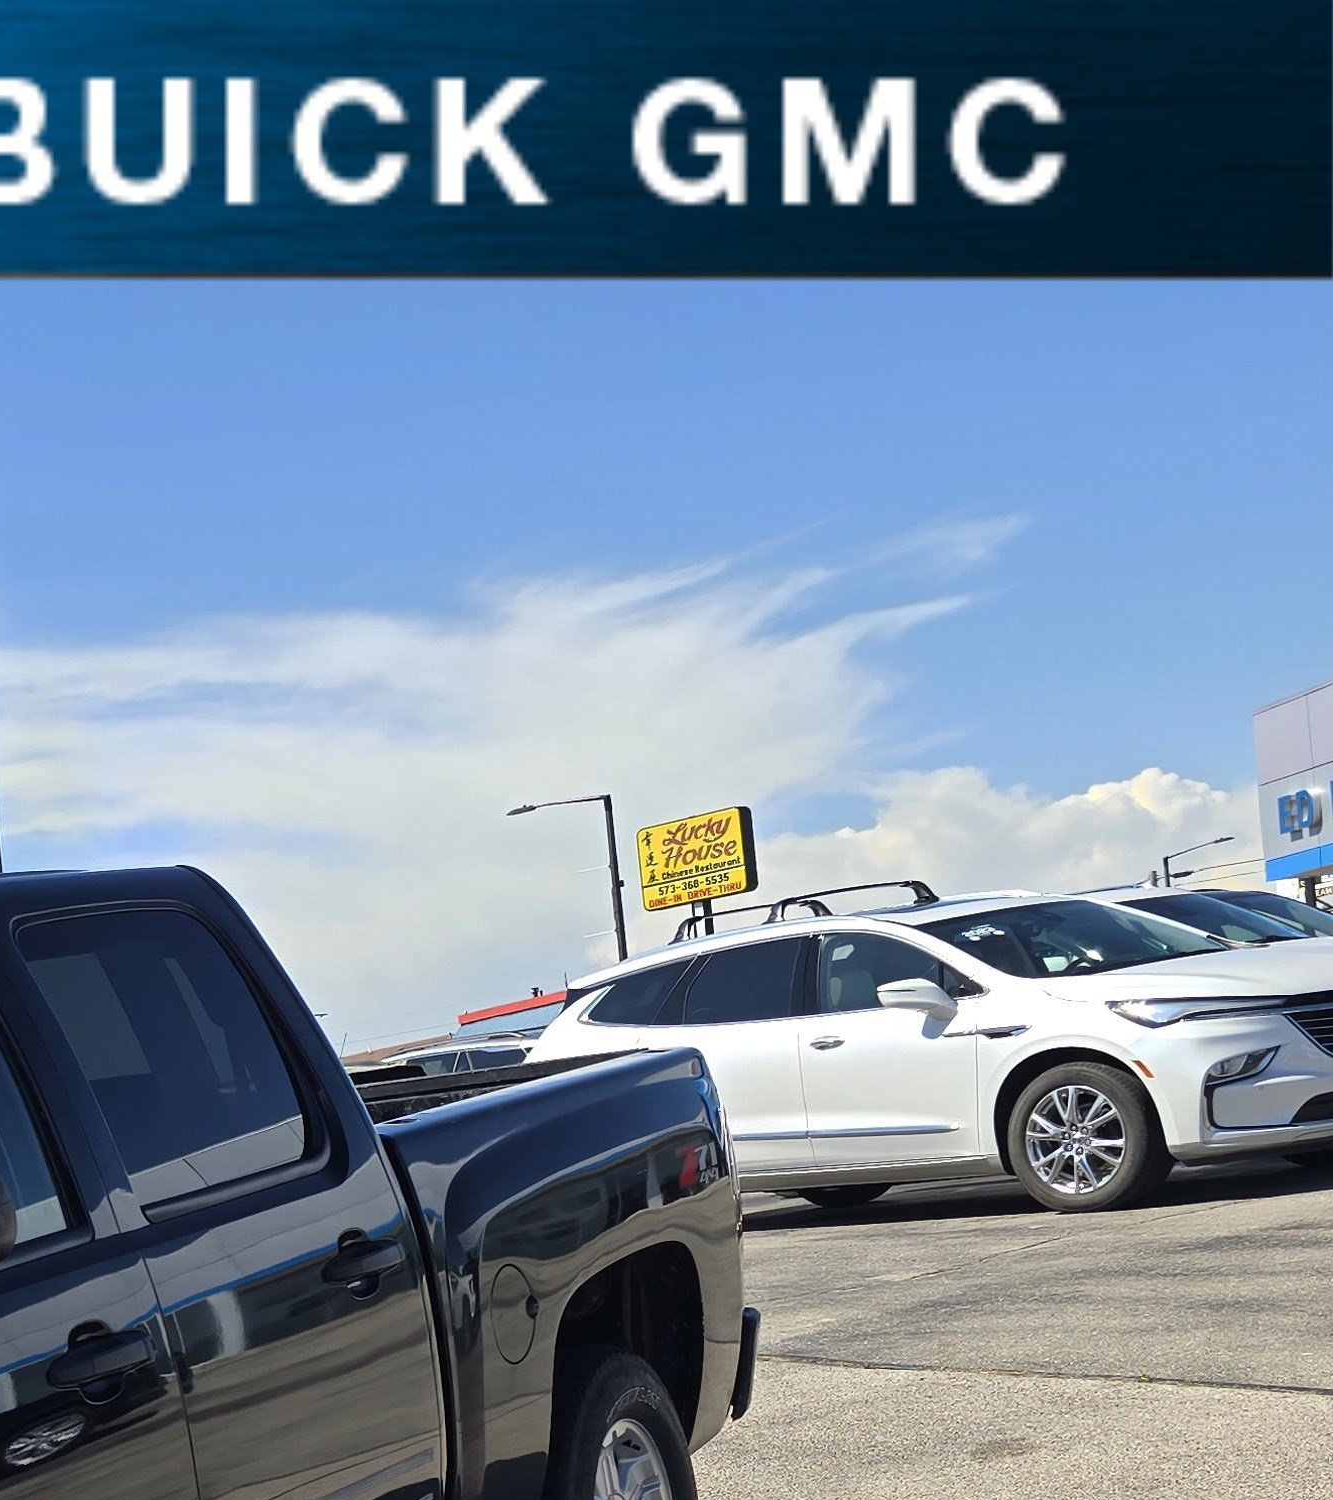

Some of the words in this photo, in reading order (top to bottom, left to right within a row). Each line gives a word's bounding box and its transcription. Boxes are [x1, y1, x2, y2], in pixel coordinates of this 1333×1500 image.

[1277, 789, 1314, 835] ED
[663, 816, 731, 846] Lucky
[661, 839, 738, 869] House
[661, 868, 694, 881] Chinese
[694, 856, 741, 875] Restaurant
[648, 894, 683, 909] DINE-IN
[687, 881, 743, 900] DRIVE-THRU
[658, 873, 730, 896] 573-368-5535
